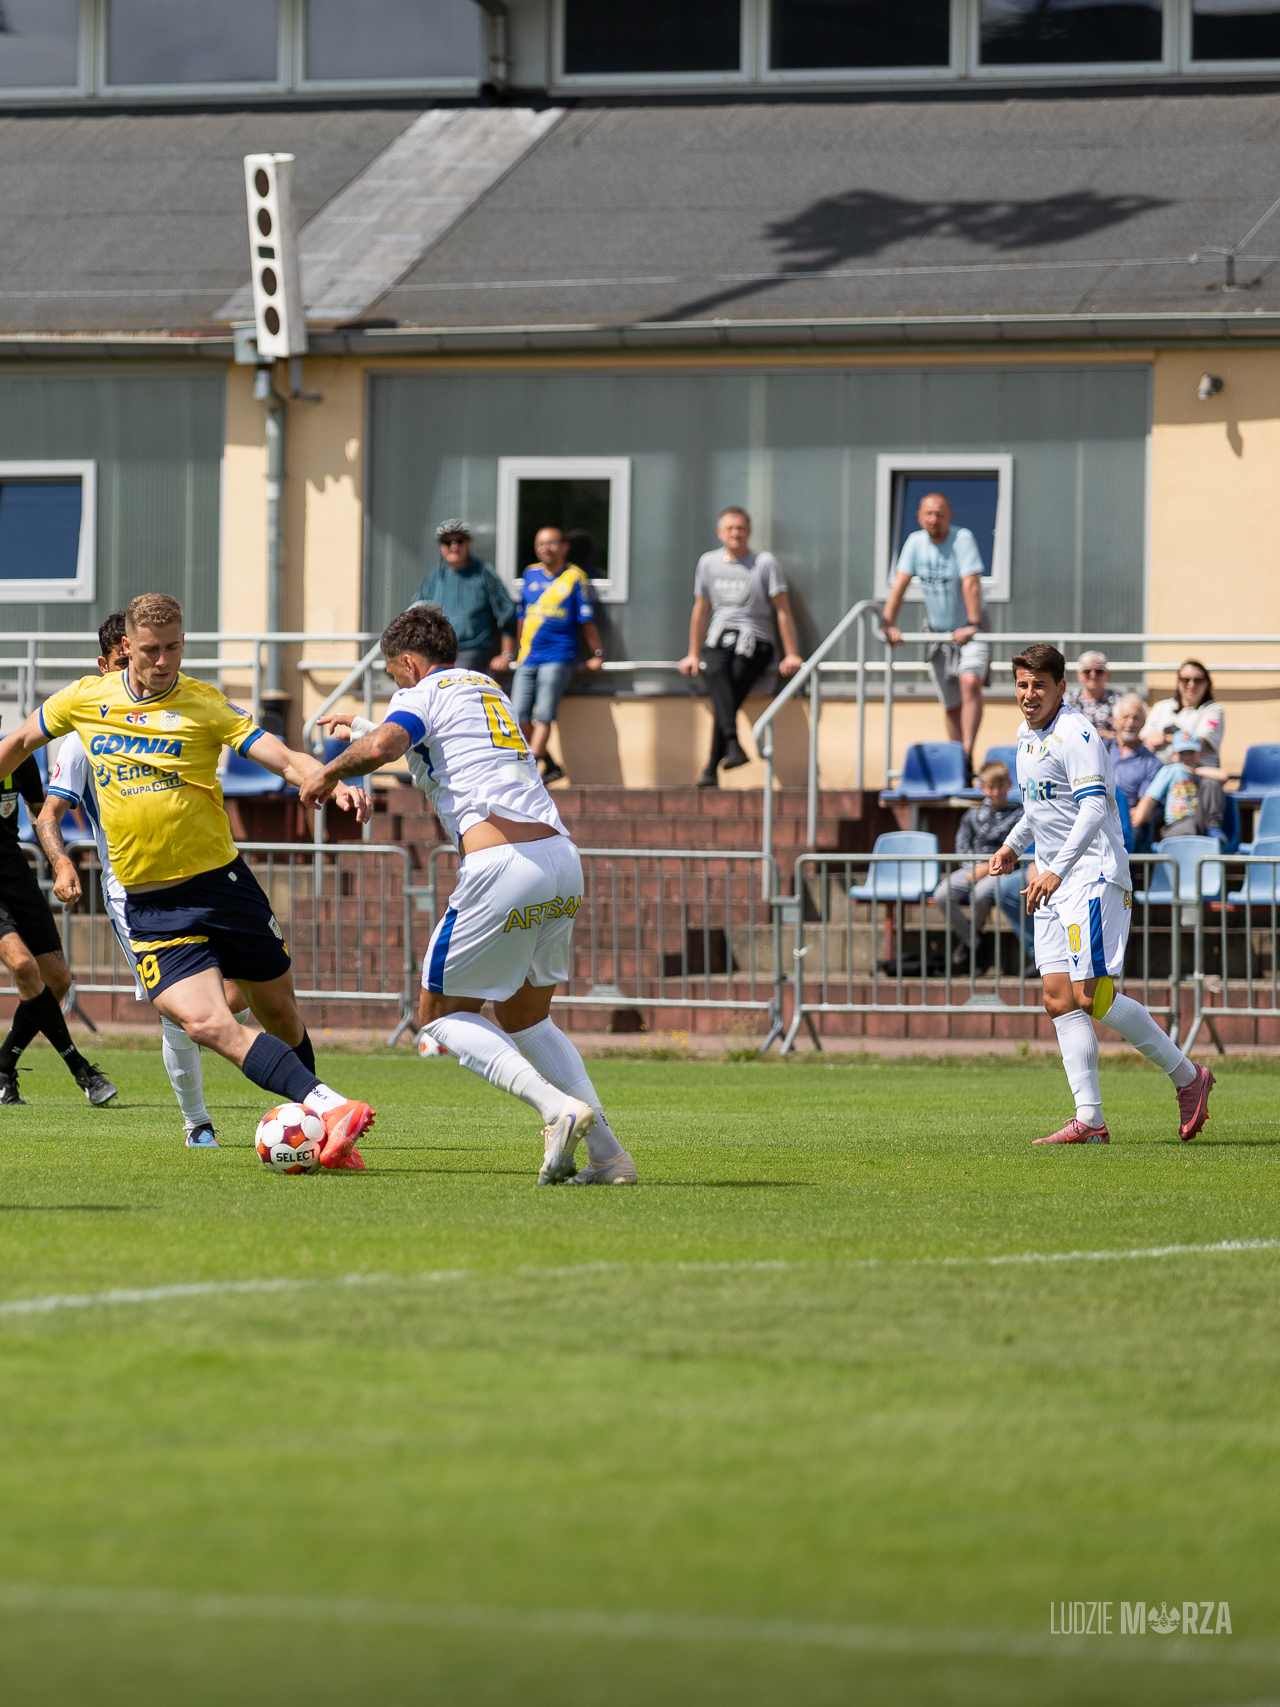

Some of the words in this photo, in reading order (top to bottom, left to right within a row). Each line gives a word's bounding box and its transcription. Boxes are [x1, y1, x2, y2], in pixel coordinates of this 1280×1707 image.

[125, 712, 147, 724] STS
[478, 690, 528, 760] 4
[90, 734, 183, 758] GDYNIA
[120, 785, 152, 797] GRUPA
[153, 778, 186, 791] ORLEN
[1068, 924, 1081, 953] 8
[276, 1149, 315, 1162] SELECT
